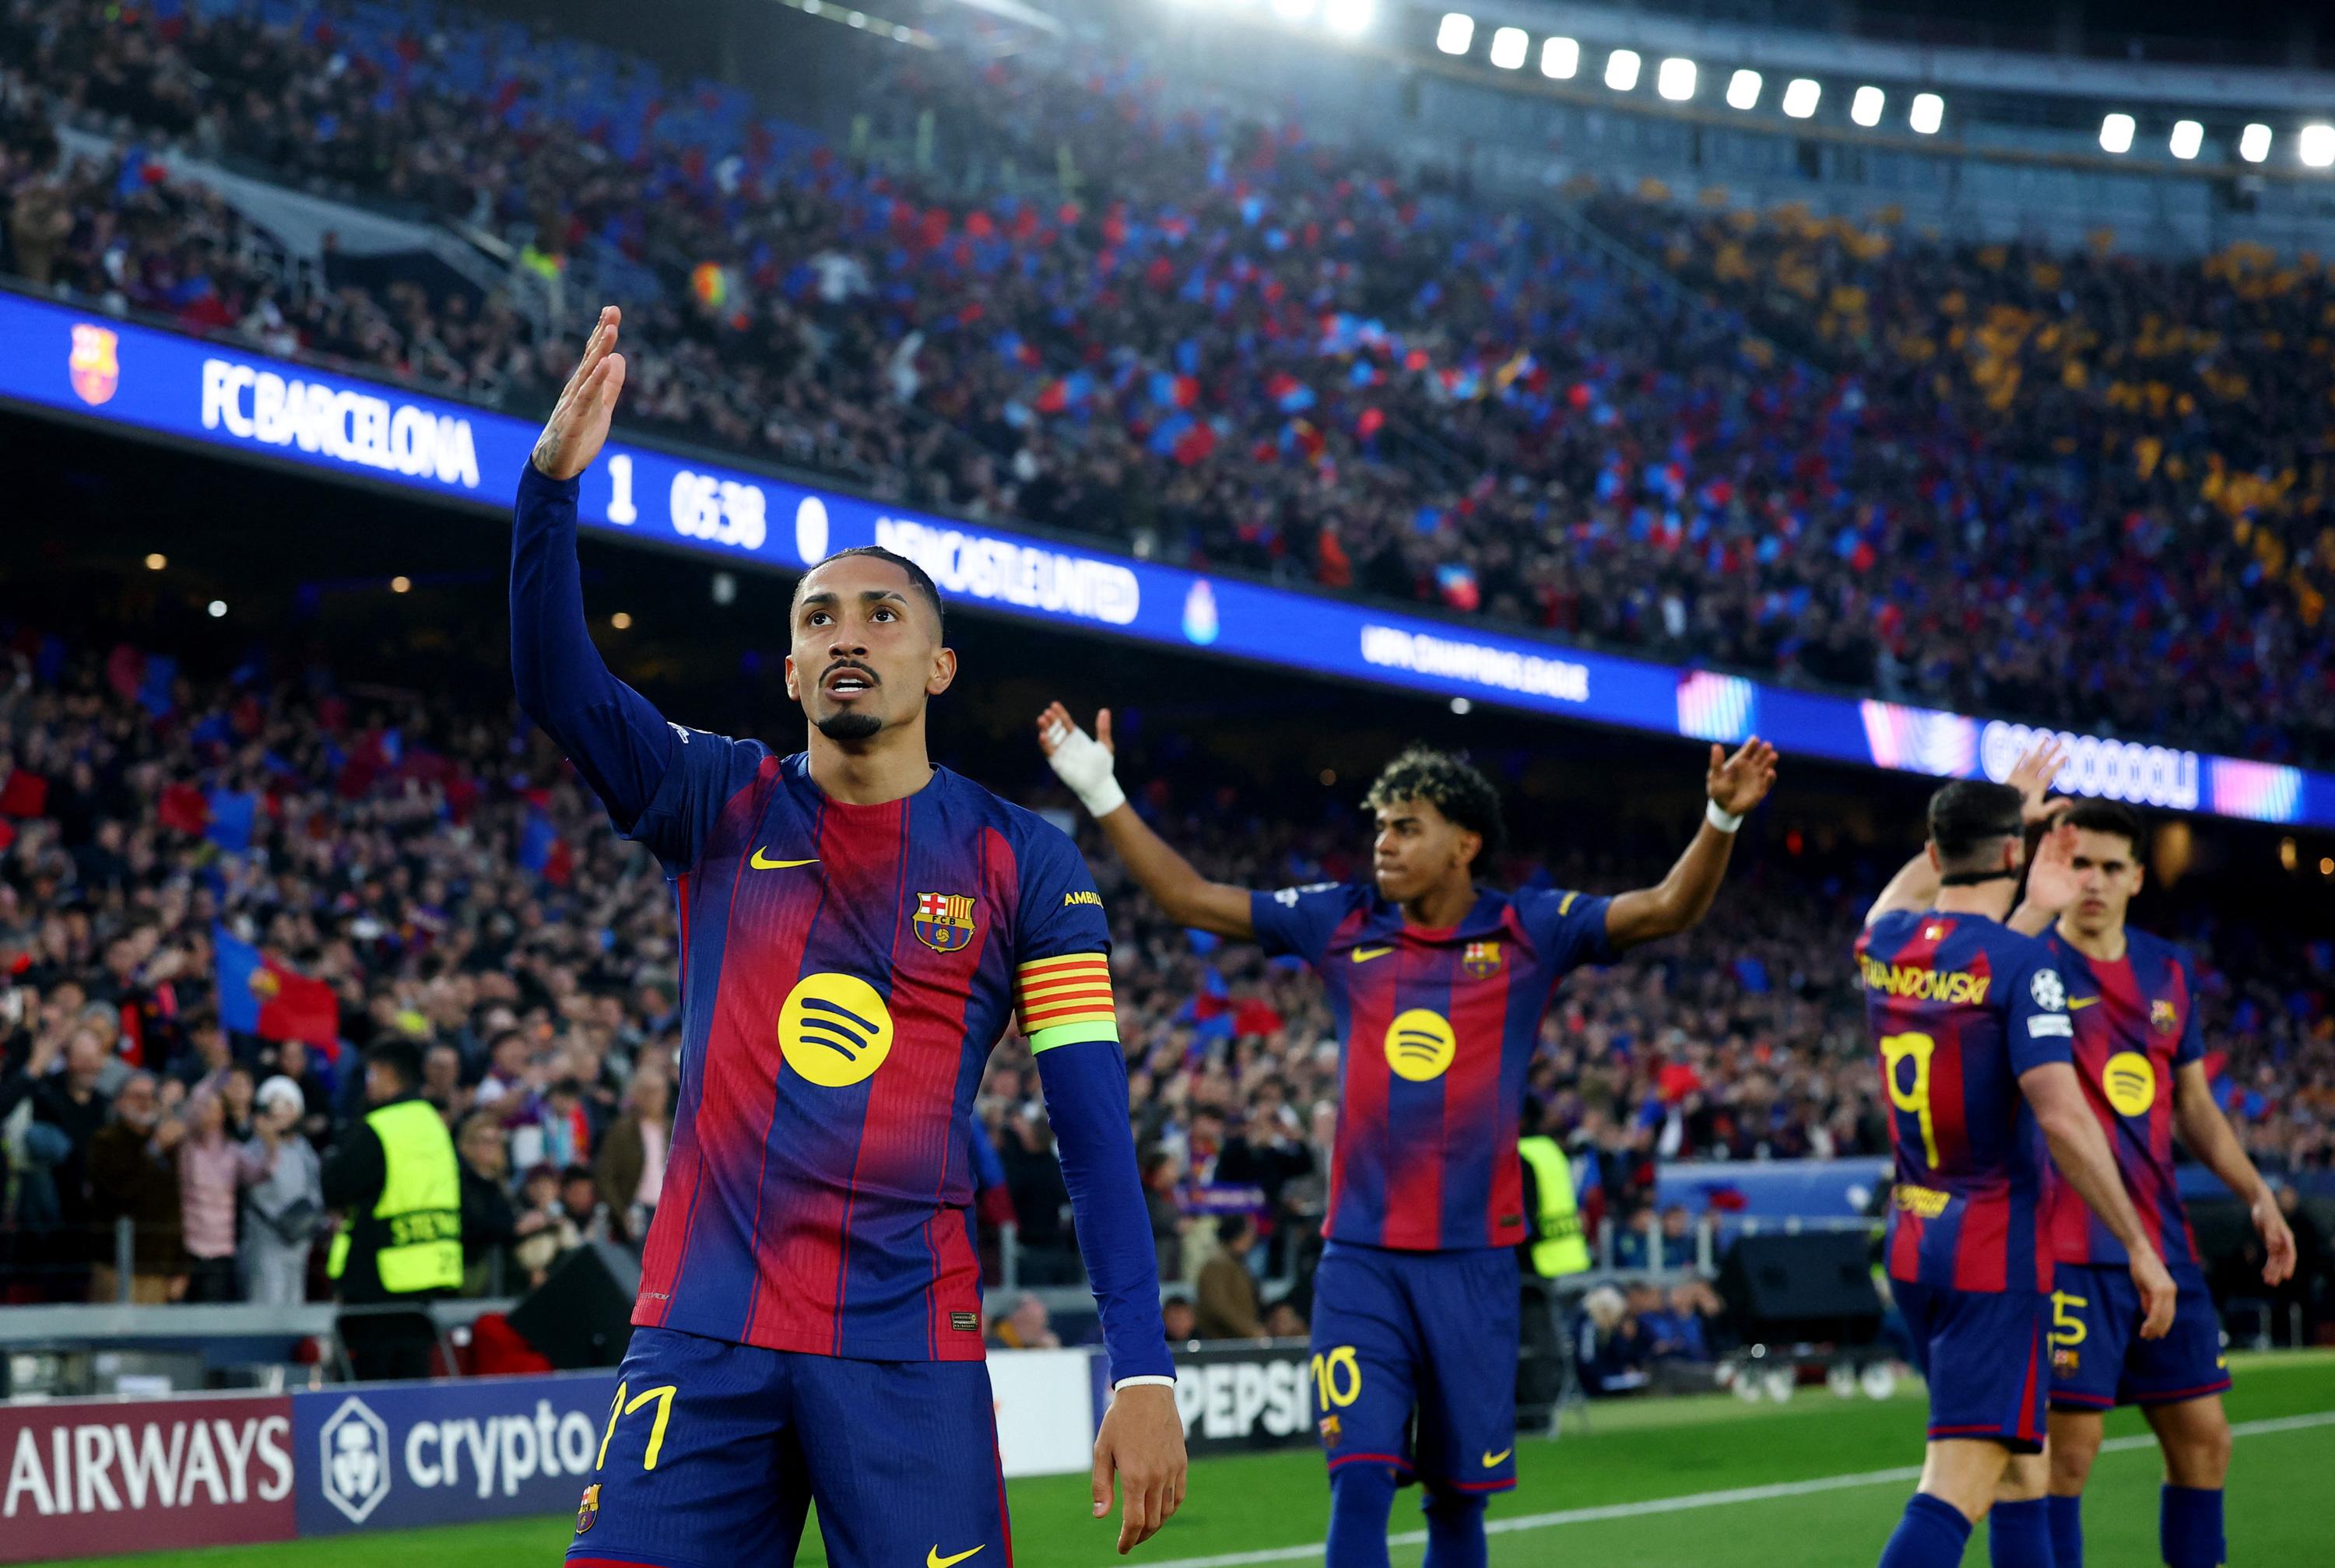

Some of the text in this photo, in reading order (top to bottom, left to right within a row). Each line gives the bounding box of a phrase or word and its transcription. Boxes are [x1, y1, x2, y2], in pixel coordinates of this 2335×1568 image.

[606, 454, 637, 526] 1
[795, 496, 829, 566] 0
[932, 915, 956, 924] FCB
[1064, 891, 1104, 909] AMBIL
[1879, 1032, 1939, 1170] 9
[1175, 1359, 1313, 1440] PEPSI
[1310, 1345, 1361, 1412] 10
[3, 1415, 294, 1518] AIRWAYS
[405, 1398, 597, 1500] crypto
